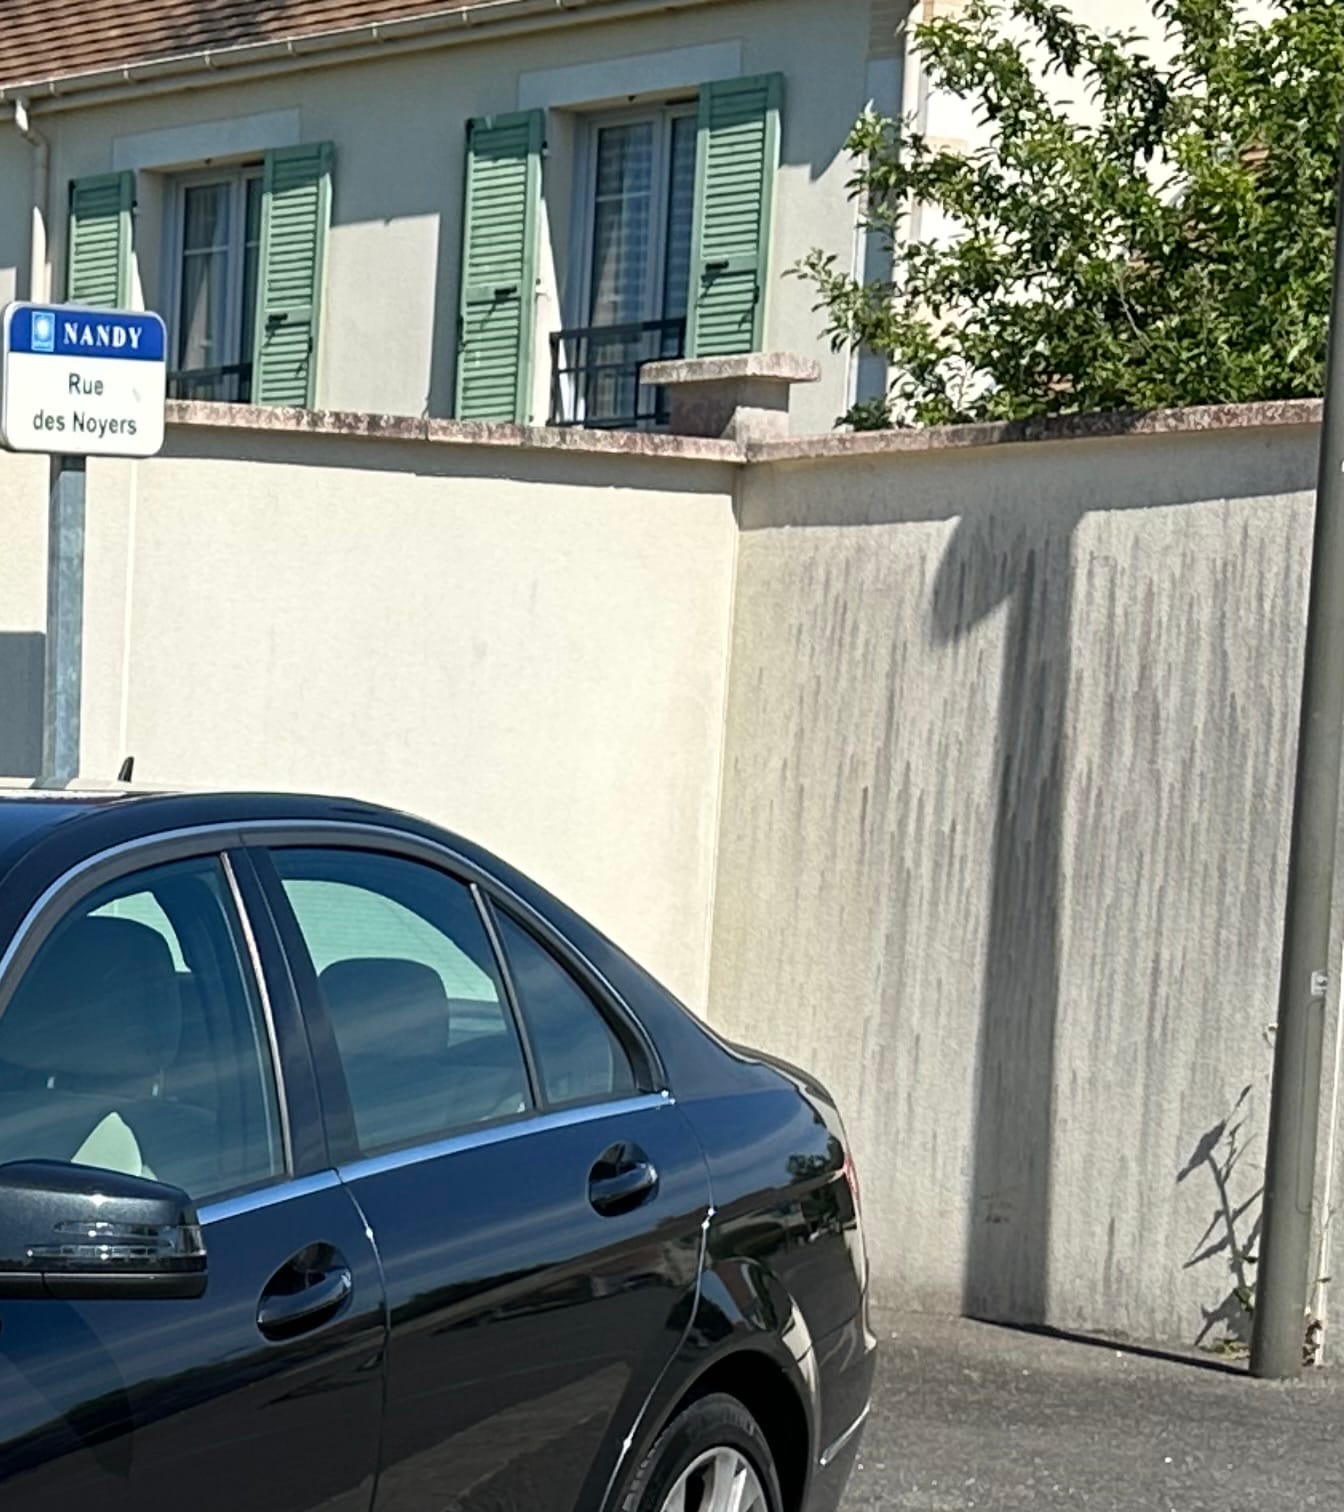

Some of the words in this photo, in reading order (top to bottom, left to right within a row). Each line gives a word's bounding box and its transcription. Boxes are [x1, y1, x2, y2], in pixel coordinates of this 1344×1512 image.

[63, 321, 143, 349] NANDY
[68, 372, 104, 396] Rue
[33, 409, 65, 431] des
[73, 411, 137, 438] Noyers
